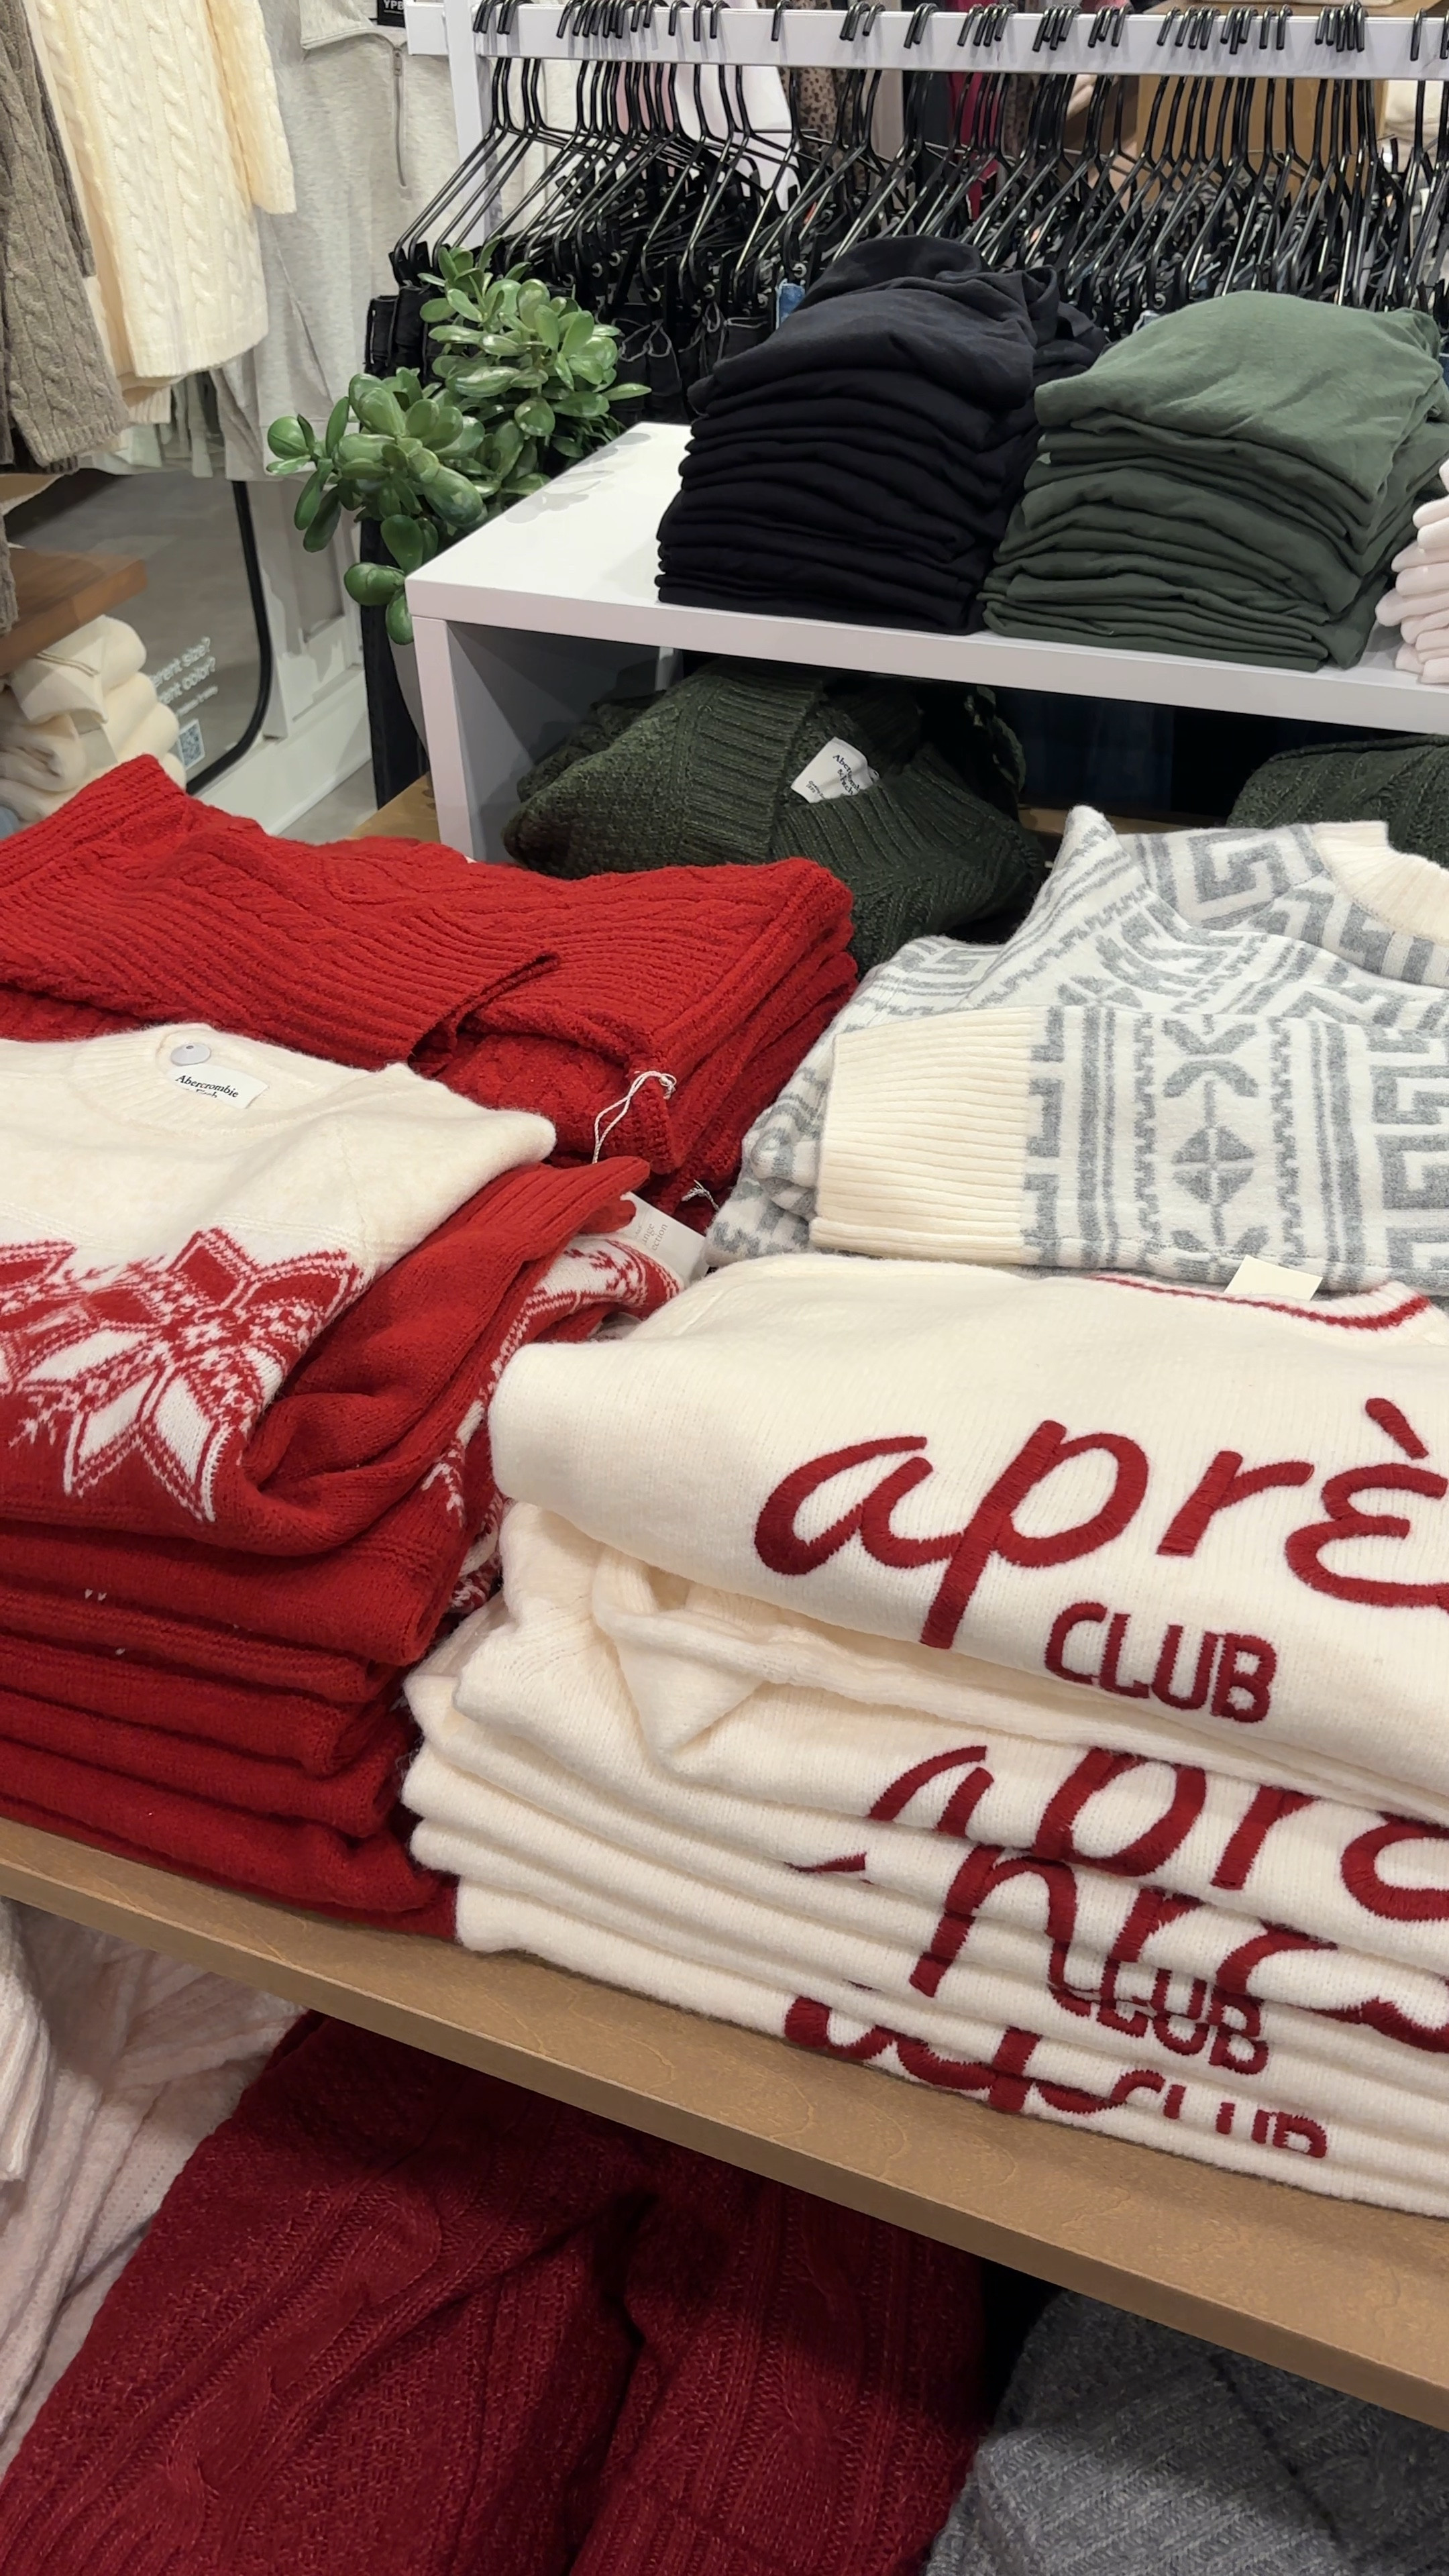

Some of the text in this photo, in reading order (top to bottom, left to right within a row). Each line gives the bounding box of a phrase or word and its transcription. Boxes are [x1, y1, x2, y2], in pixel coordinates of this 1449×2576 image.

[383, 0, 404, 10] YPB
[181, 636, 211, 667] size?
[182, 656, 216, 690] color?
[175, 1075, 239, 1098] Abercrombie
[651, 1224, 669, 1252] ection
[754, 1397, 1449, 1650] aprè
[1044, 1601, 1279, 1724] CLUB
